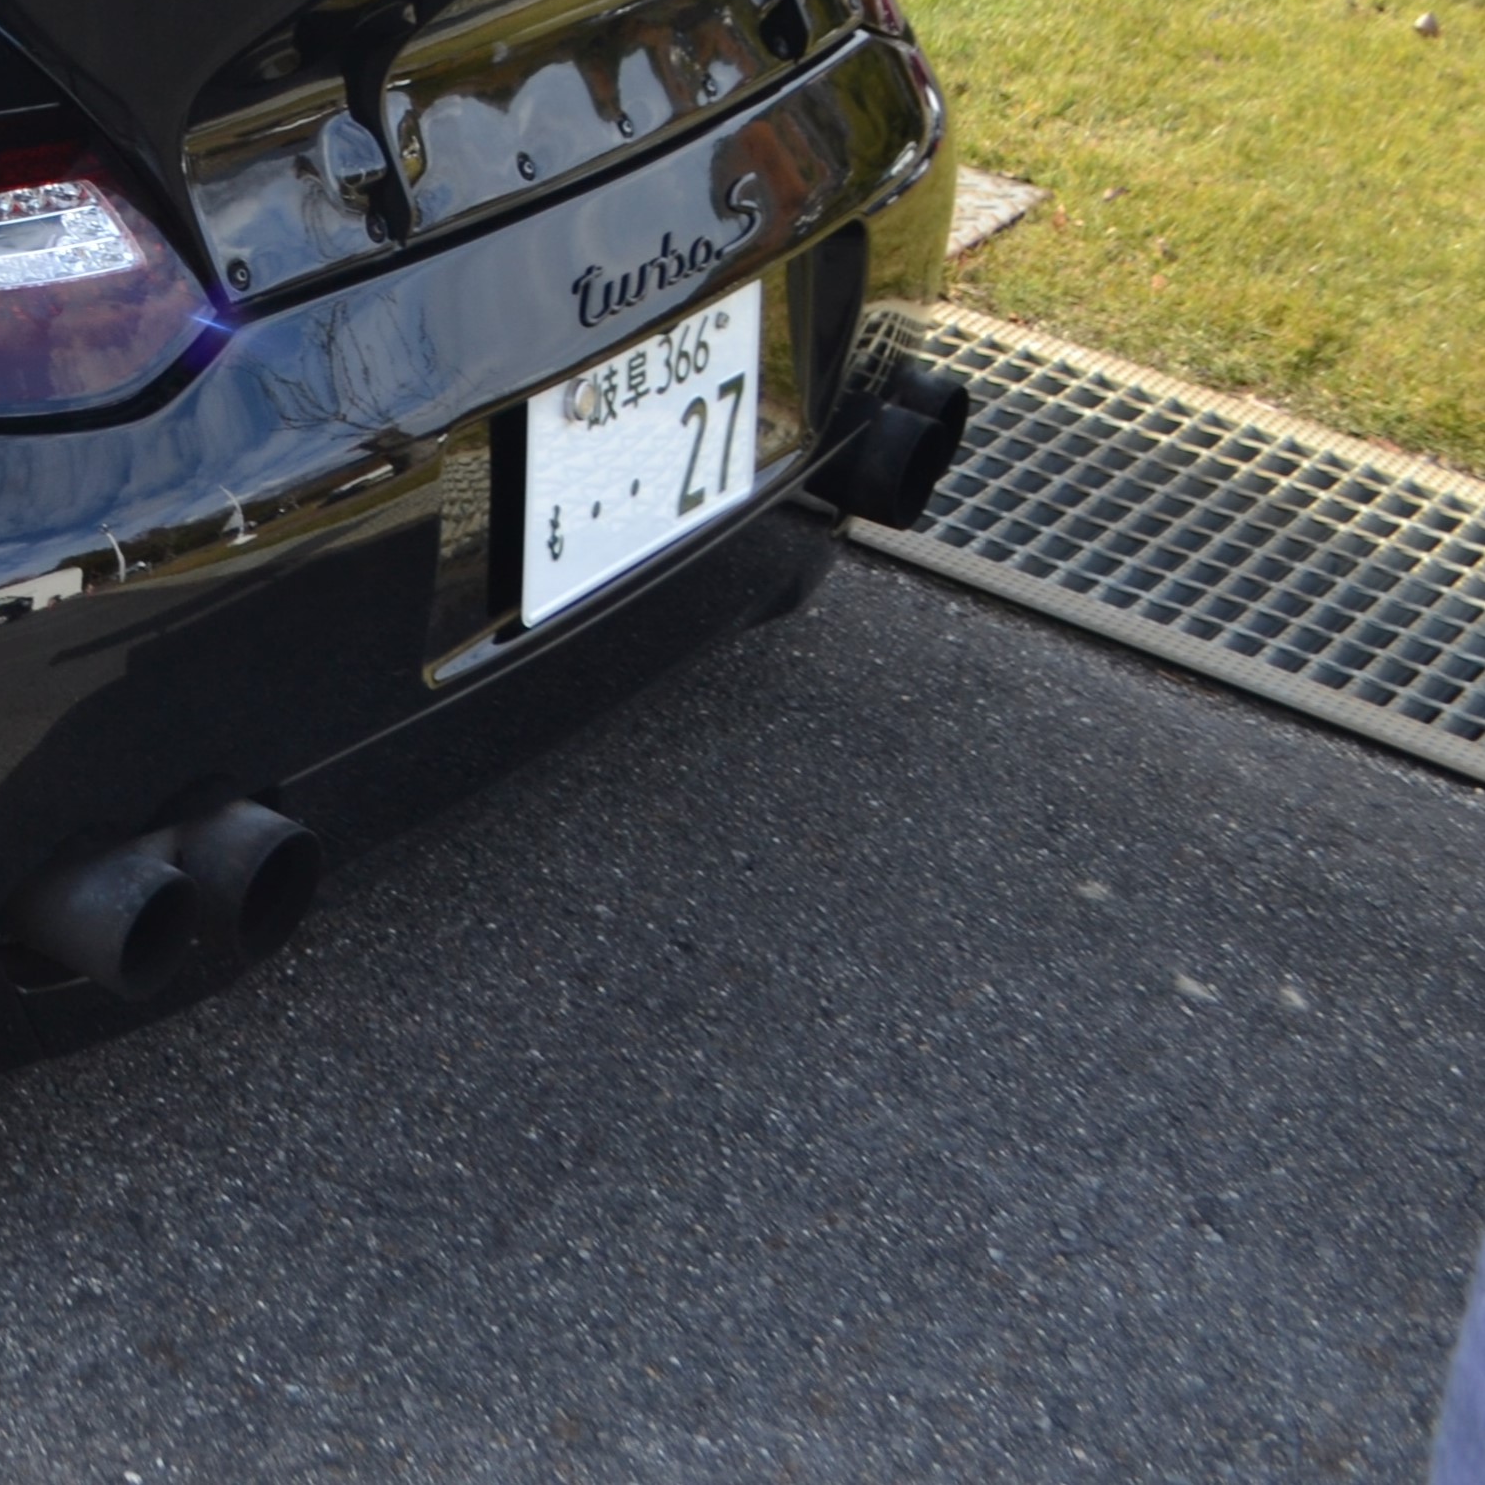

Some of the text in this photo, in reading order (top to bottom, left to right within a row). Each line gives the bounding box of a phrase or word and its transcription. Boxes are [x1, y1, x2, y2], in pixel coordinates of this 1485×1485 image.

[571, 171, 762, 328] turbo S
[547, 503, 564, 562] も
